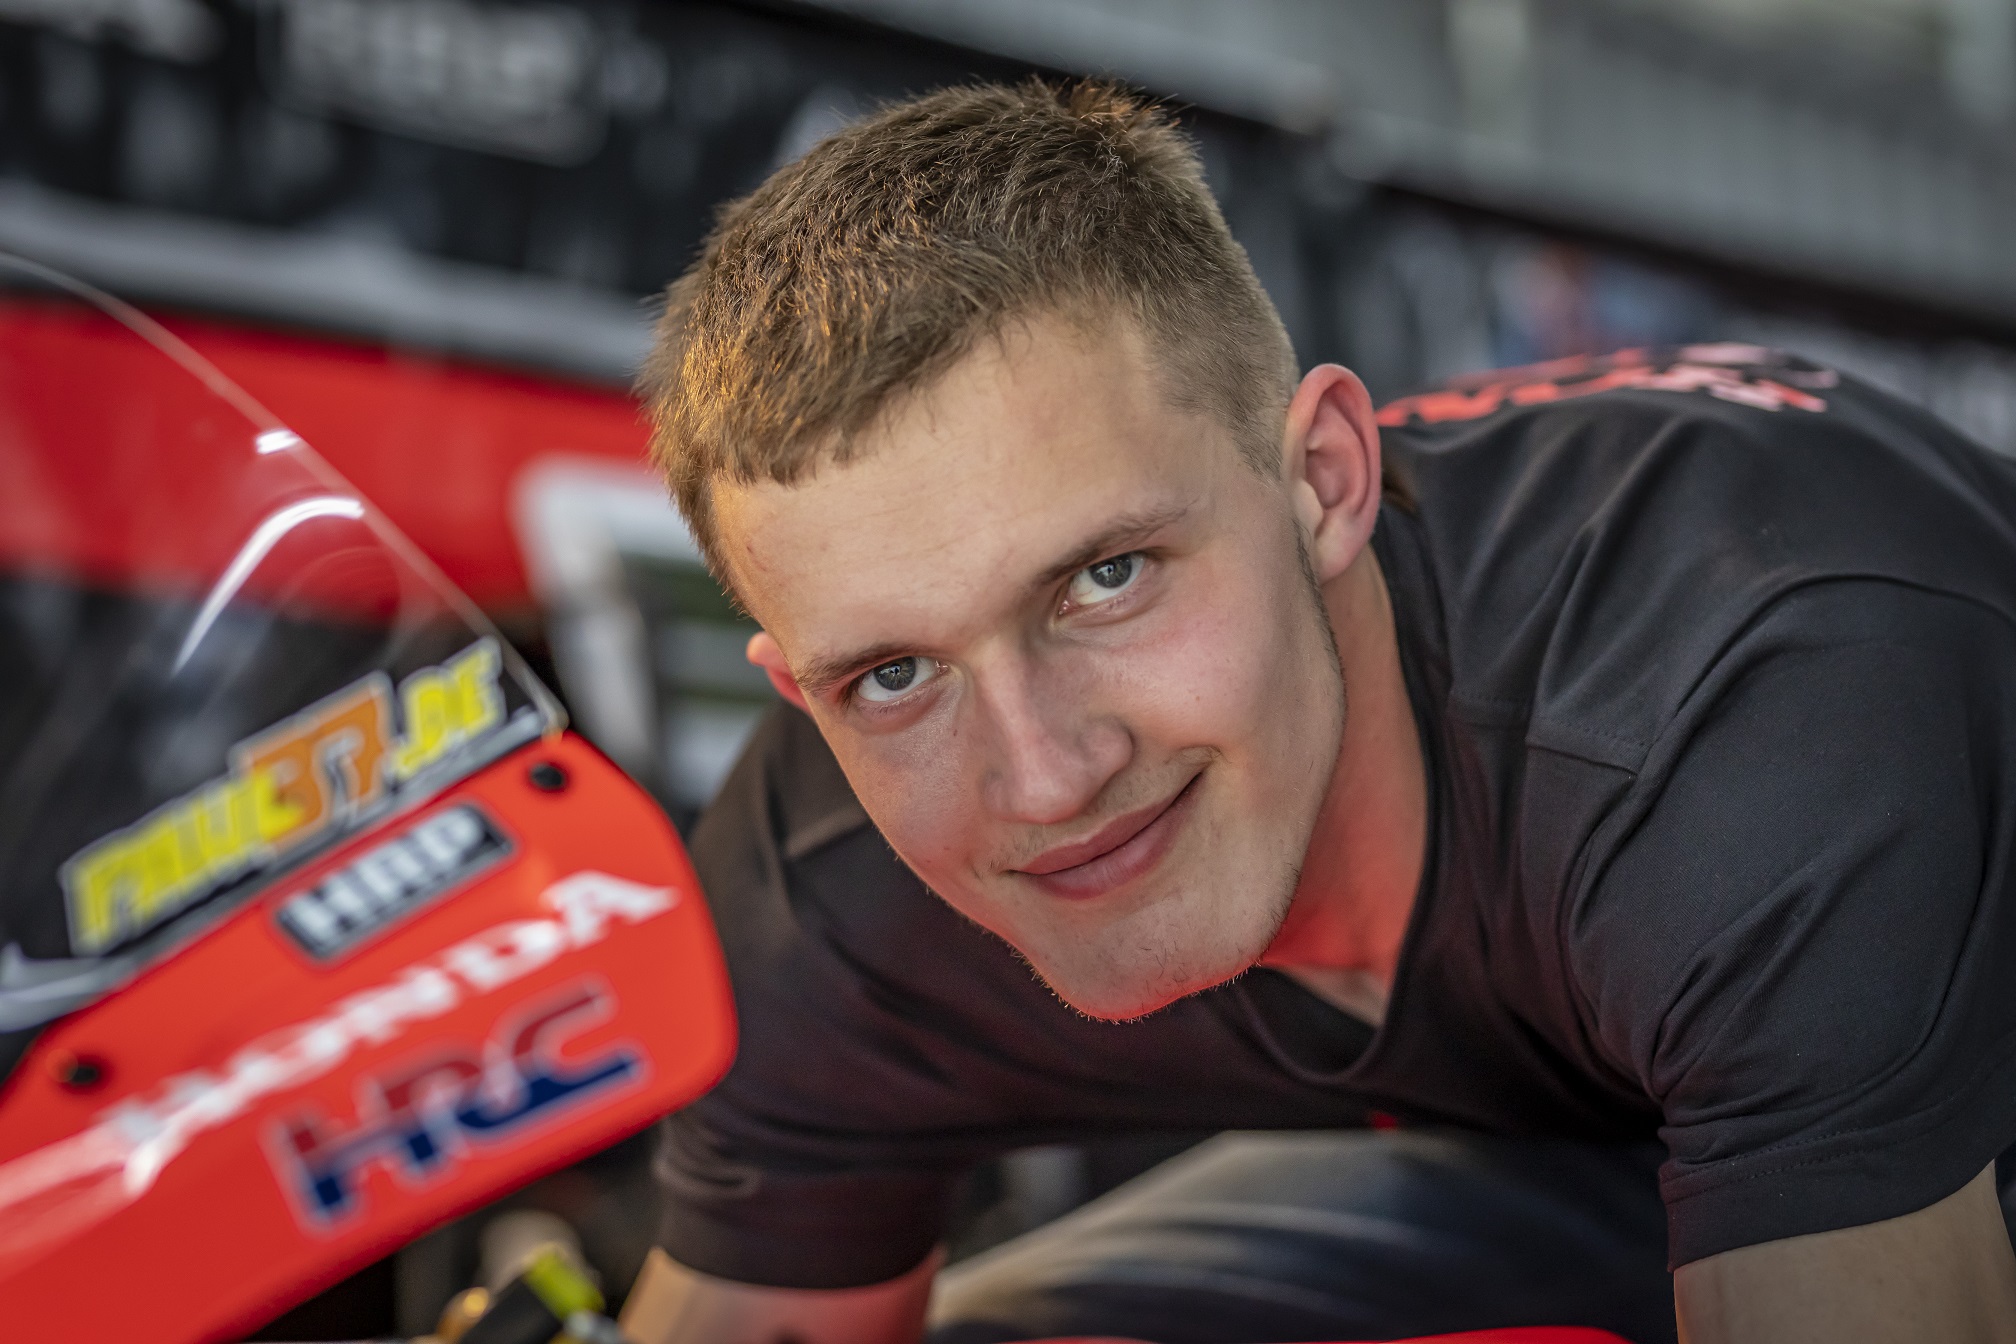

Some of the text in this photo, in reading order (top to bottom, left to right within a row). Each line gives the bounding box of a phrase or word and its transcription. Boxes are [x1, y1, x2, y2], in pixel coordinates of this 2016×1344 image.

[283, 806, 490, 942] HRP
[95, 870, 676, 1168] HONDA
[272, 980, 646, 1228] HRC
